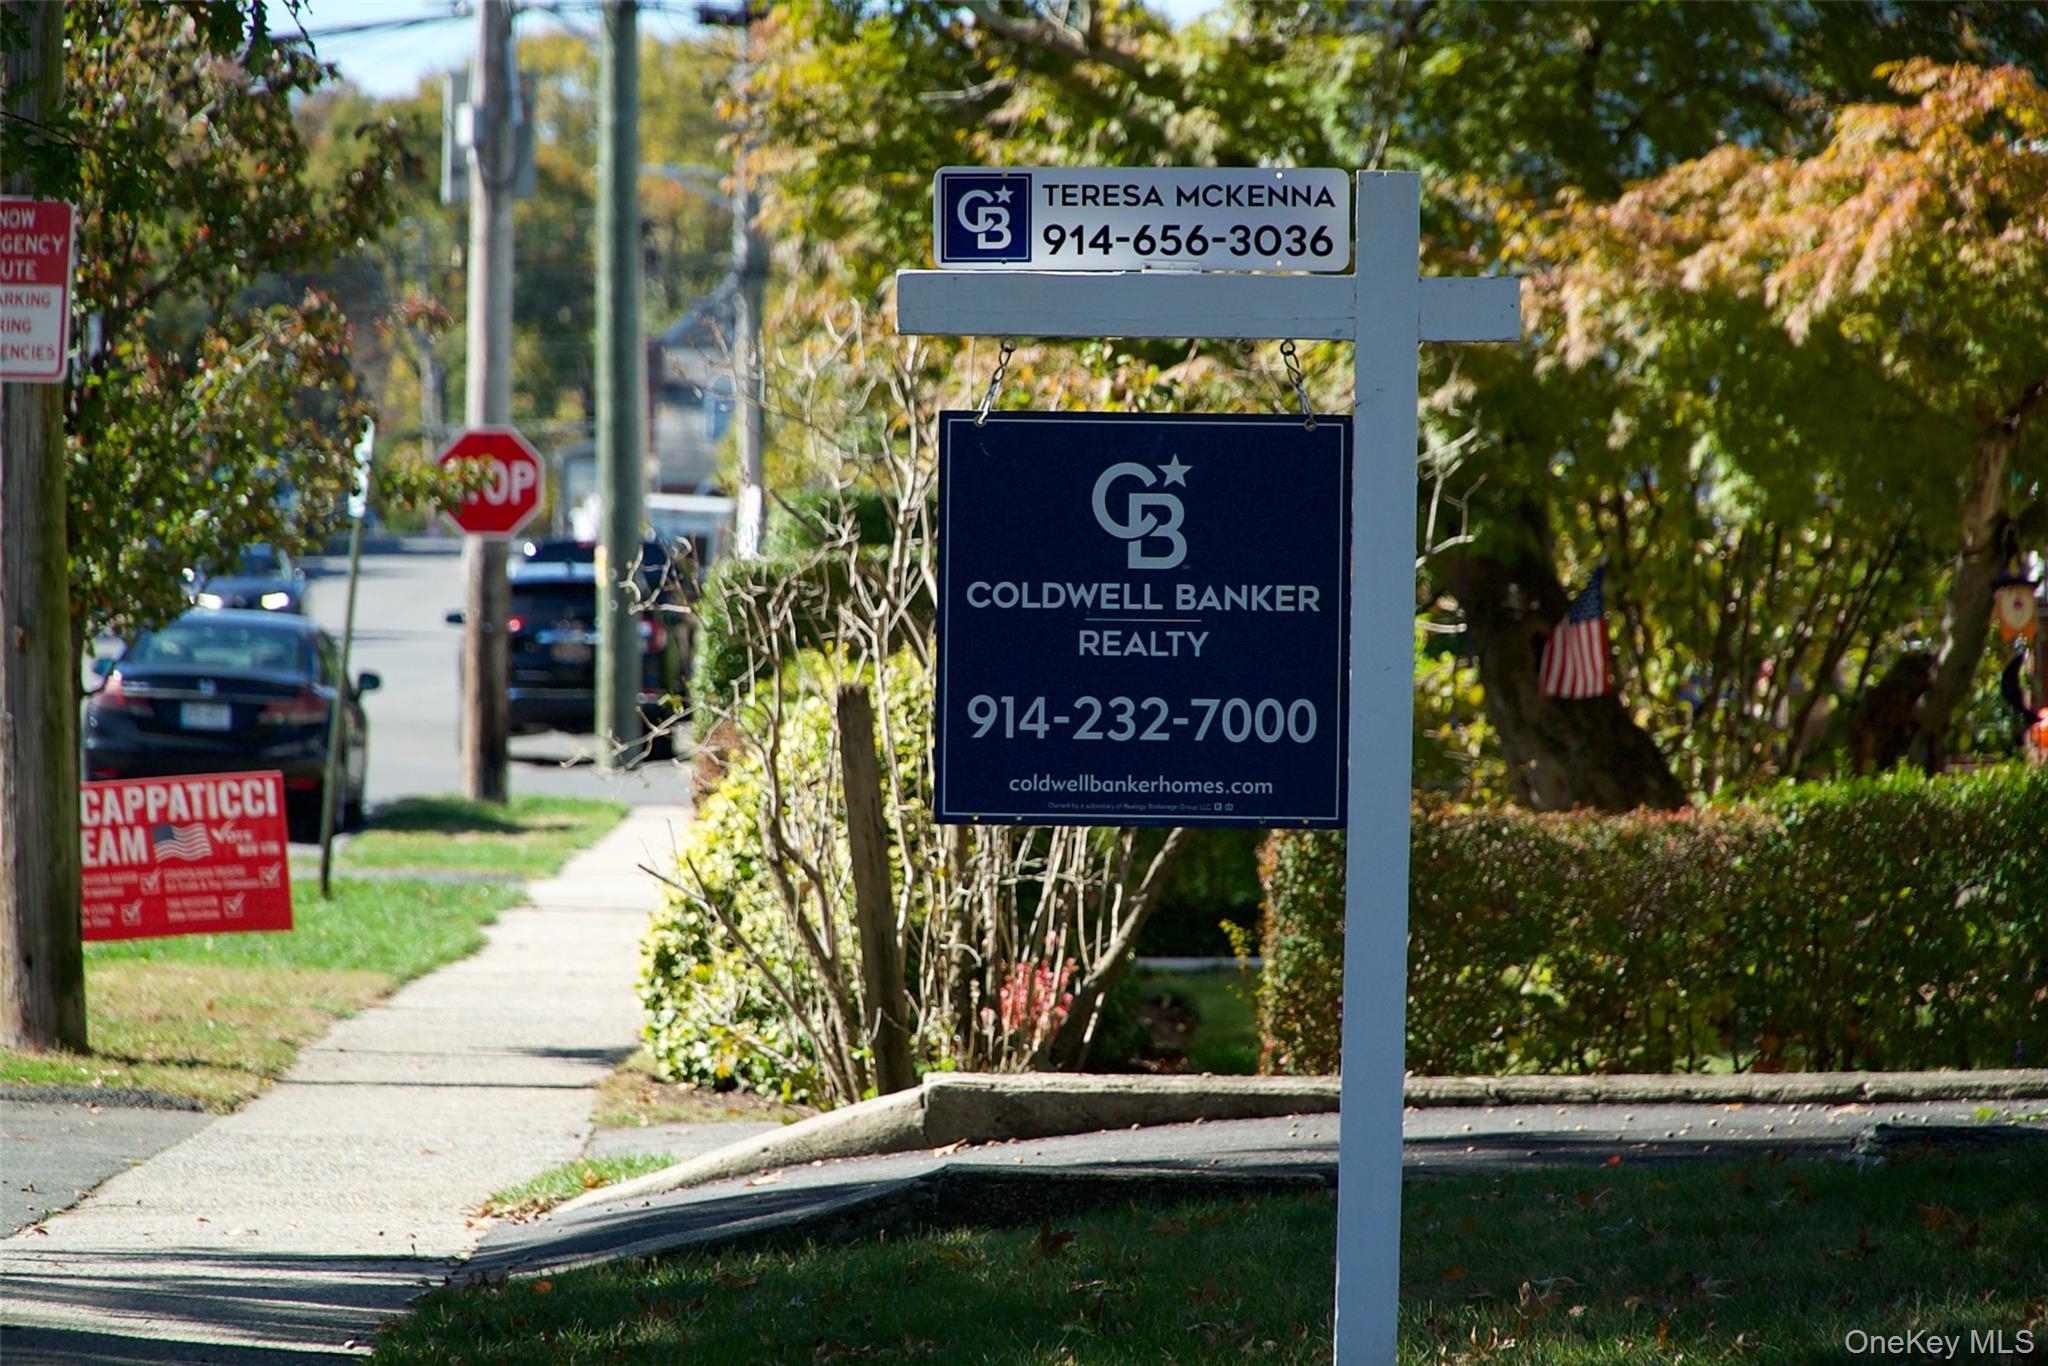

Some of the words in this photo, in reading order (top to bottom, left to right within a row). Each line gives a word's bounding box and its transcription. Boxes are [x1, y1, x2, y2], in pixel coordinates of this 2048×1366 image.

[1042, 184, 1164, 207] TERESA
[1176, 184, 1336, 207] MCKENNA
[1042, 223, 1334, 257] 914-656-3036
[454, 459, 536, 506] OP
[966, 581, 1164, 610] COLDWELL
[1175, 583, 1321, 612] BANKER
[1078, 630, 1209, 657] REALTY
[967, 694, 1318, 744] 914-232-7000
[1008, 774, 1273, 794] coldwellbankerhomes.com
